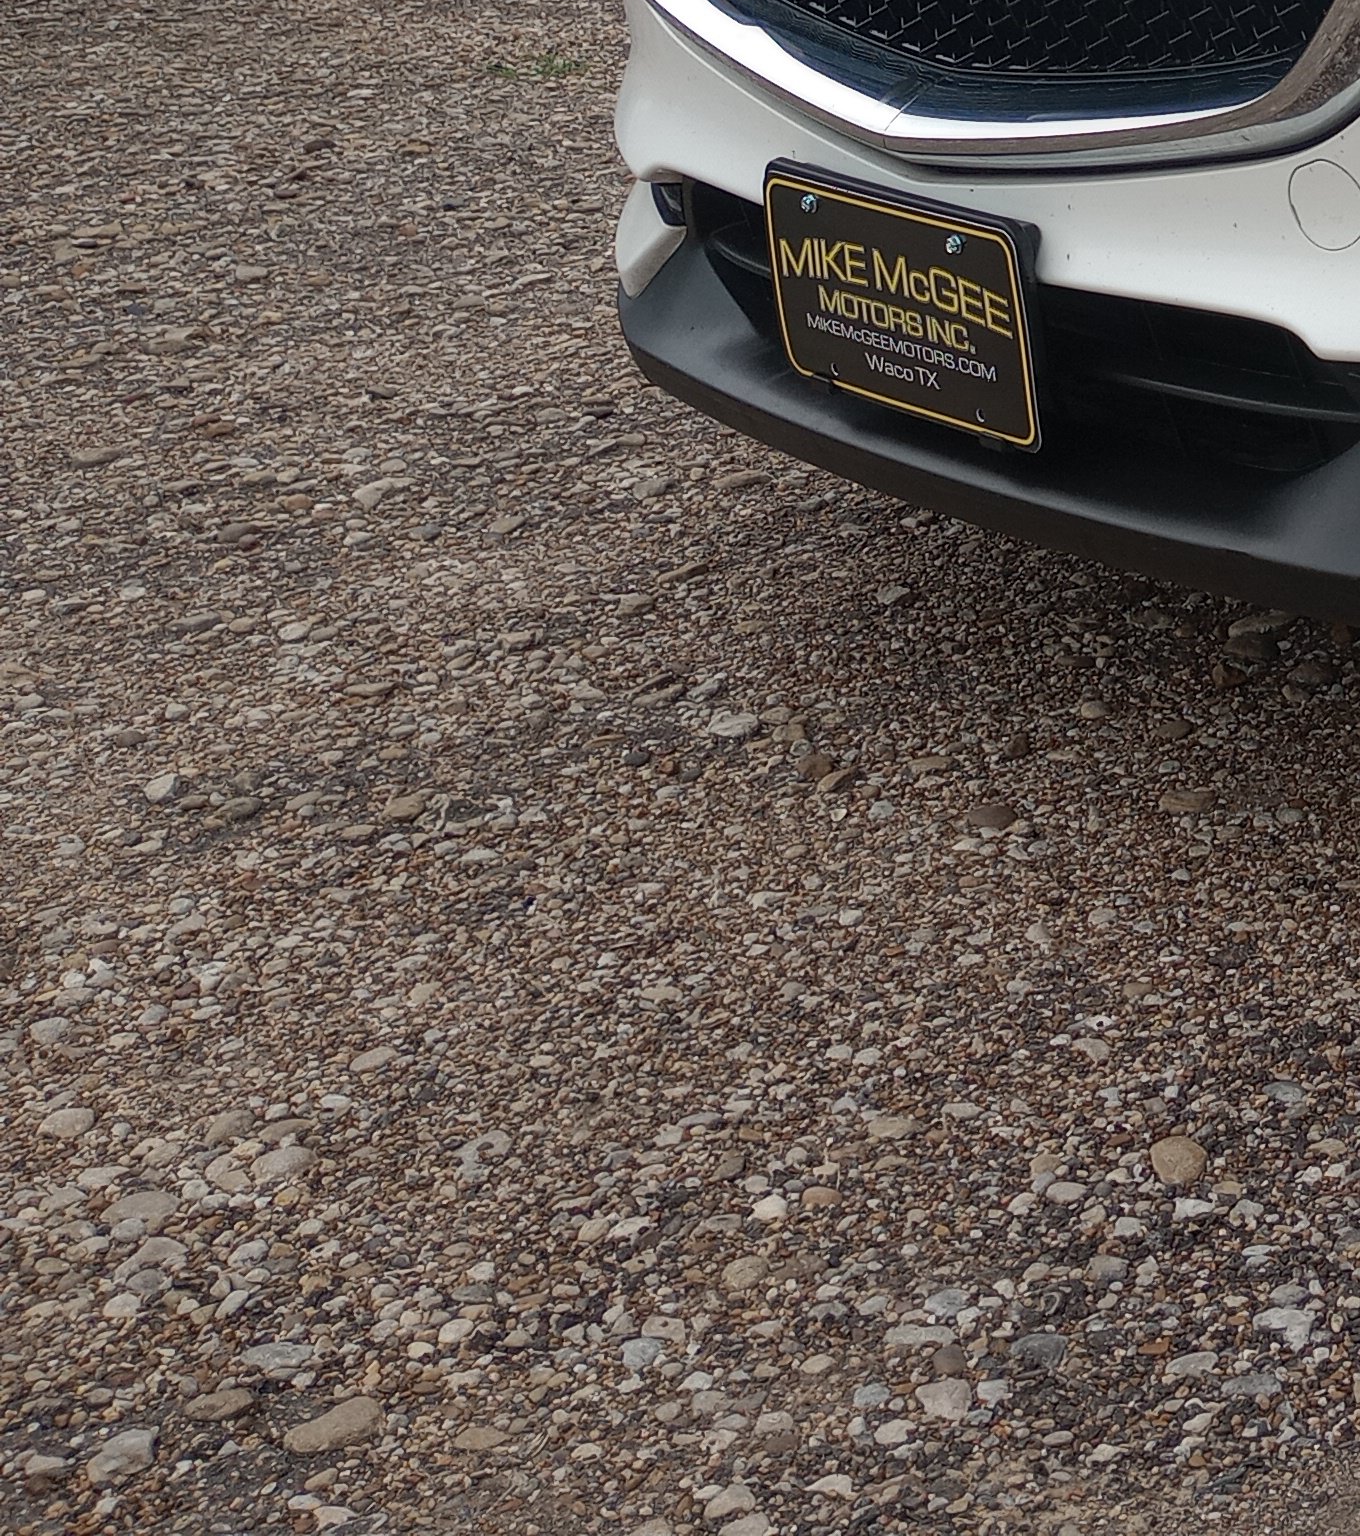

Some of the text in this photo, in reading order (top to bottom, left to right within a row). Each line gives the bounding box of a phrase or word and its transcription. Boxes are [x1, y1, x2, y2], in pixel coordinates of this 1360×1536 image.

[778, 238, 1013, 340] MIKE McGEE
[817, 284, 977, 356] MOTORS INC.
[864, 352, 942, 390] Waco TX
